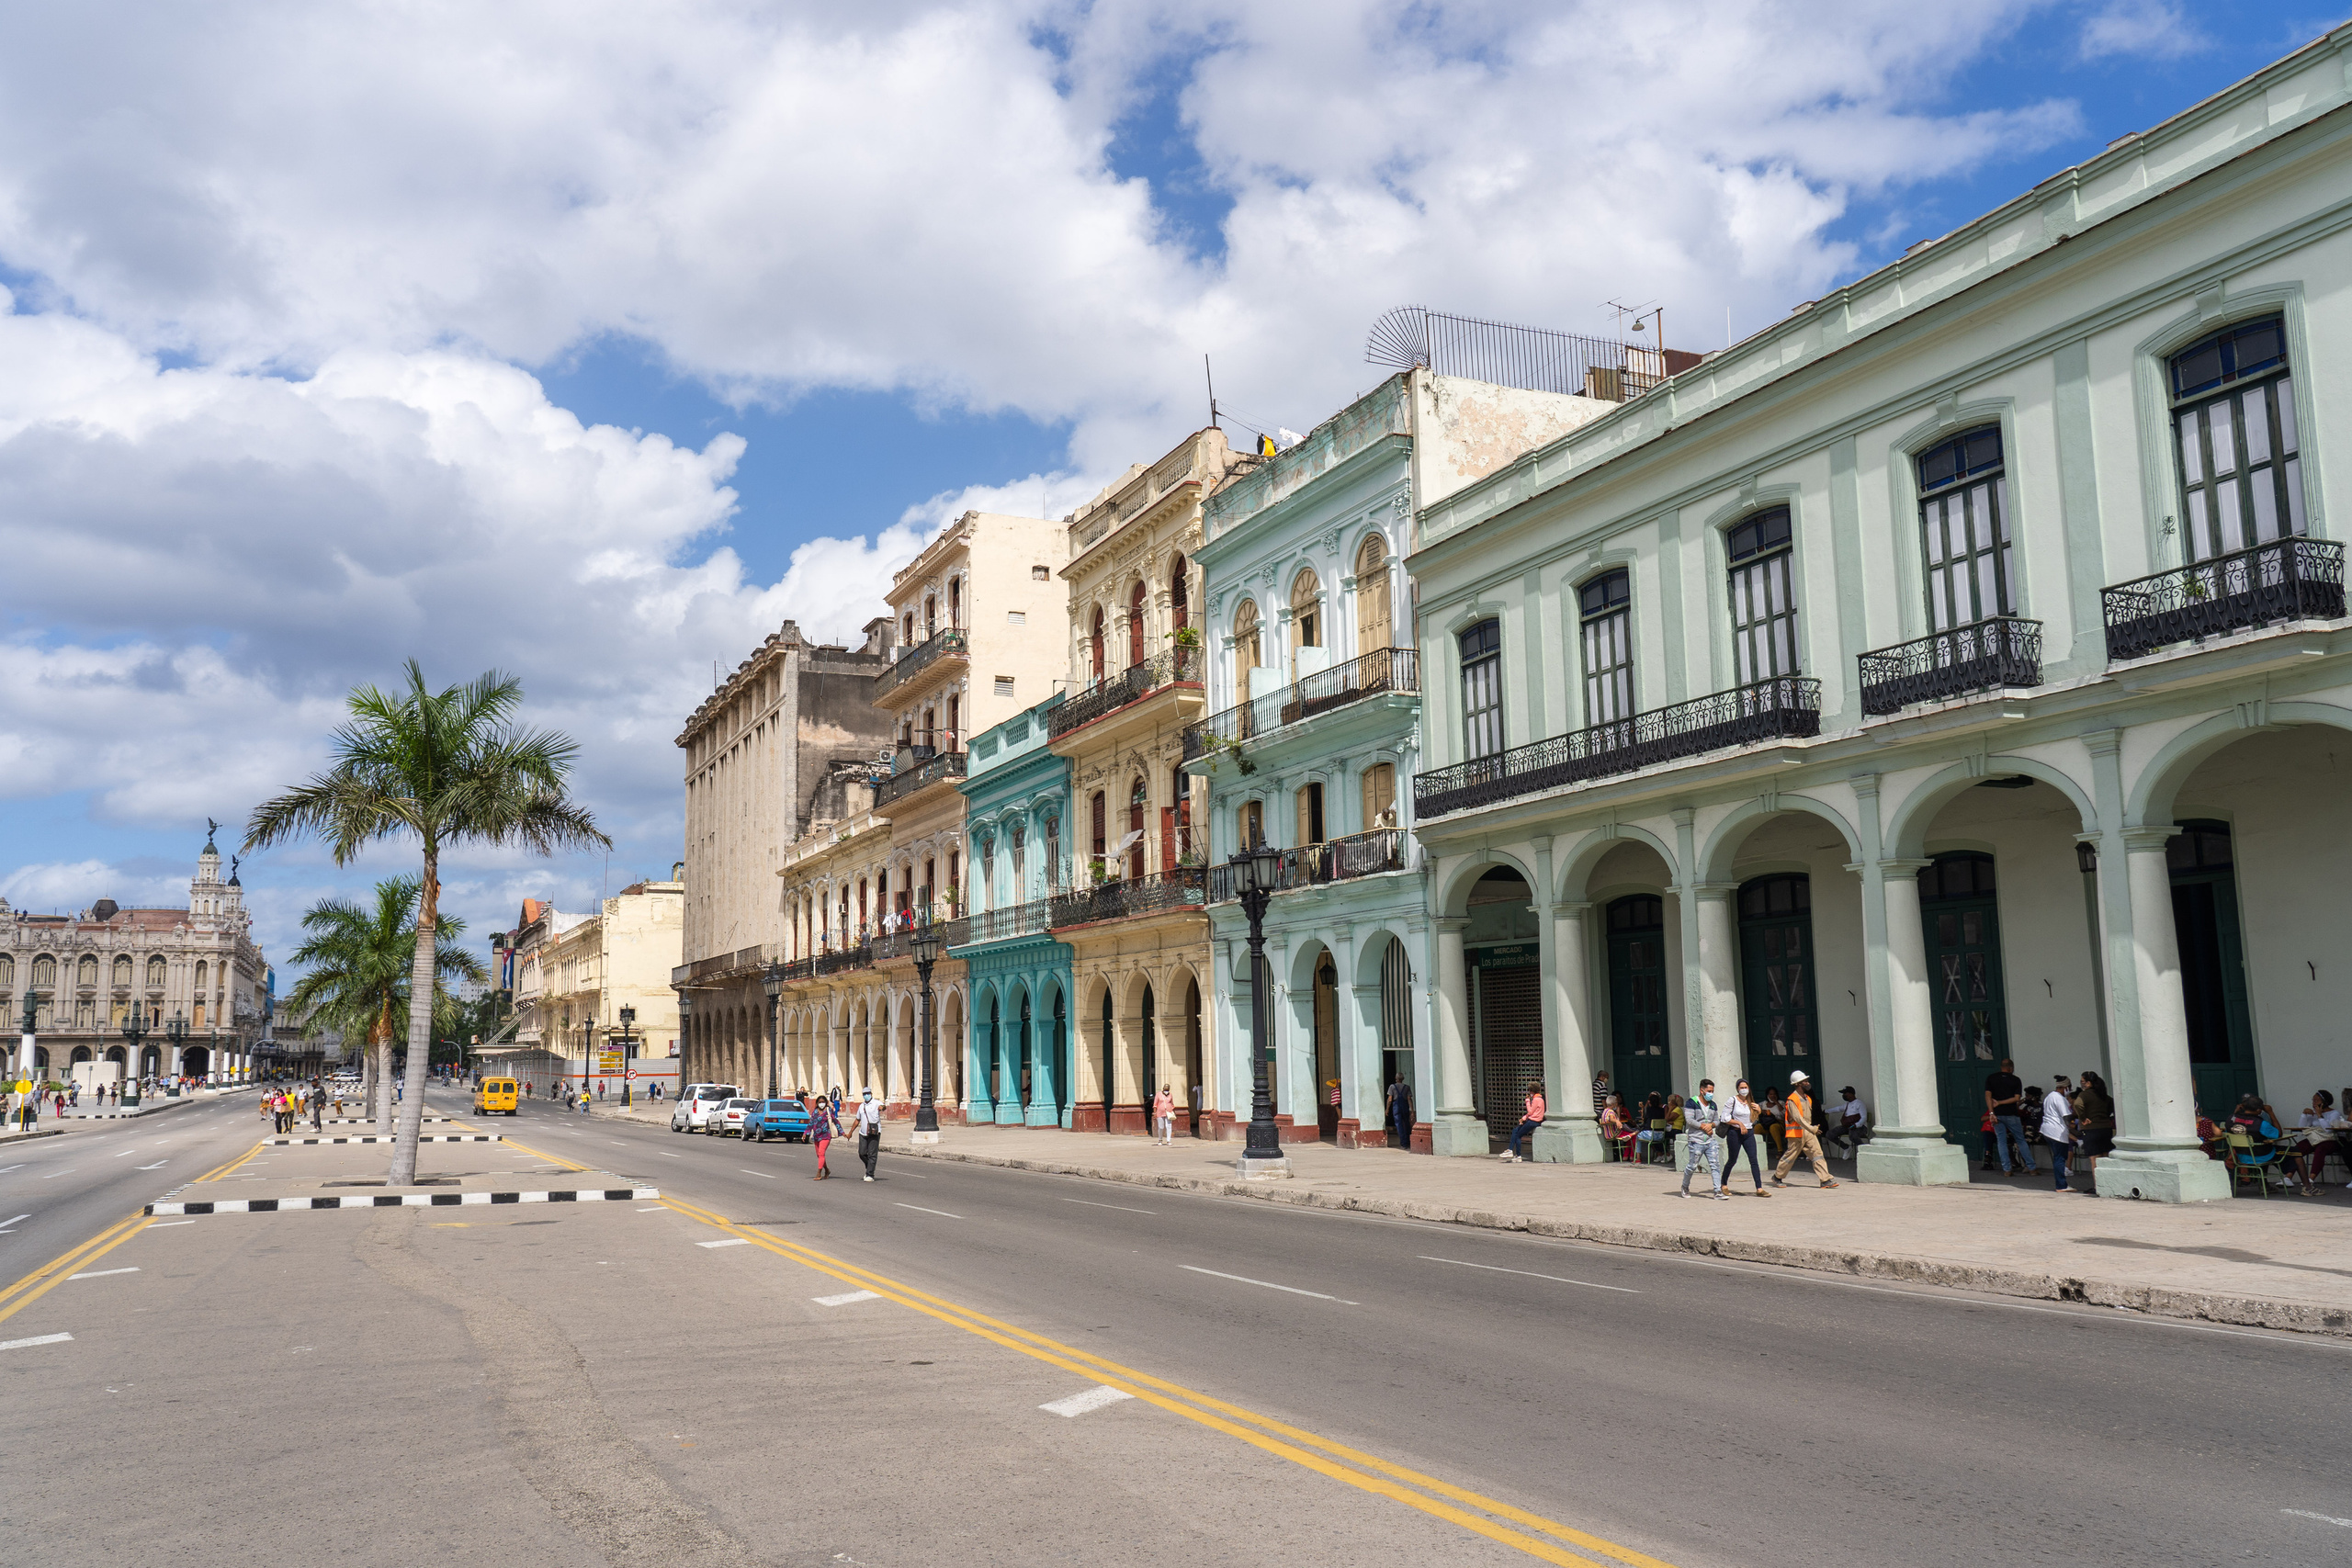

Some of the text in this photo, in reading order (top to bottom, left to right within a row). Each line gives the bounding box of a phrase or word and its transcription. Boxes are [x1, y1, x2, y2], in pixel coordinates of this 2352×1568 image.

[1494, 946, 1522, 954] MERCADO
[1481, 957, 1491, 966] Los
[1517, 954, 1524, 964] de
[1525, 953, 1540, 964] Prad
